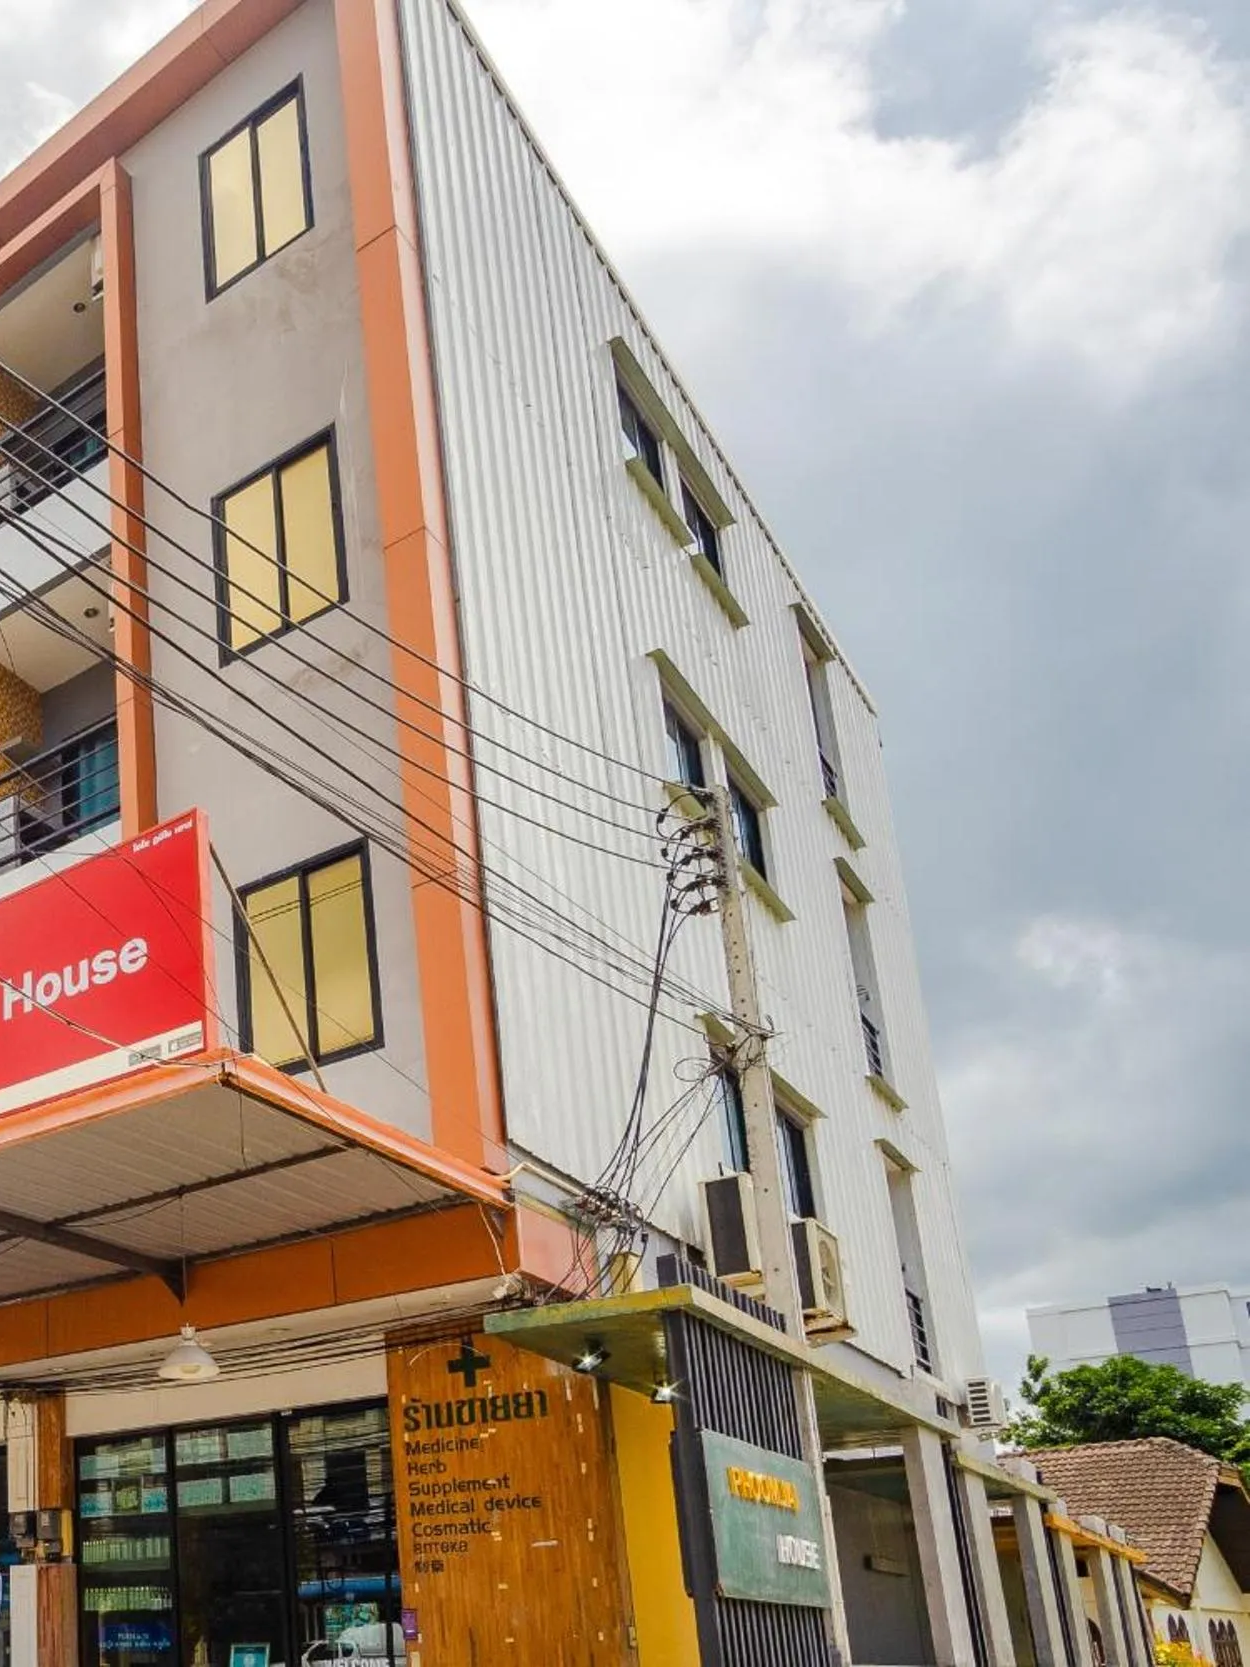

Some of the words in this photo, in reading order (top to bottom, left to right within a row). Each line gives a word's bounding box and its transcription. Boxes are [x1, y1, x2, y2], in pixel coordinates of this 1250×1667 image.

[2, 936, 149, 1021] House
[404, 1436, 481, 1456] Medicine
[406, 1459, 448, 1476] Herb
[408, 1473, 511, 1498] Supplement
[410, 1498, 476, 1518] Medical
[483, 1495, 543, 1512] device
[412, 1518, 493, 1538] Cosmatic
